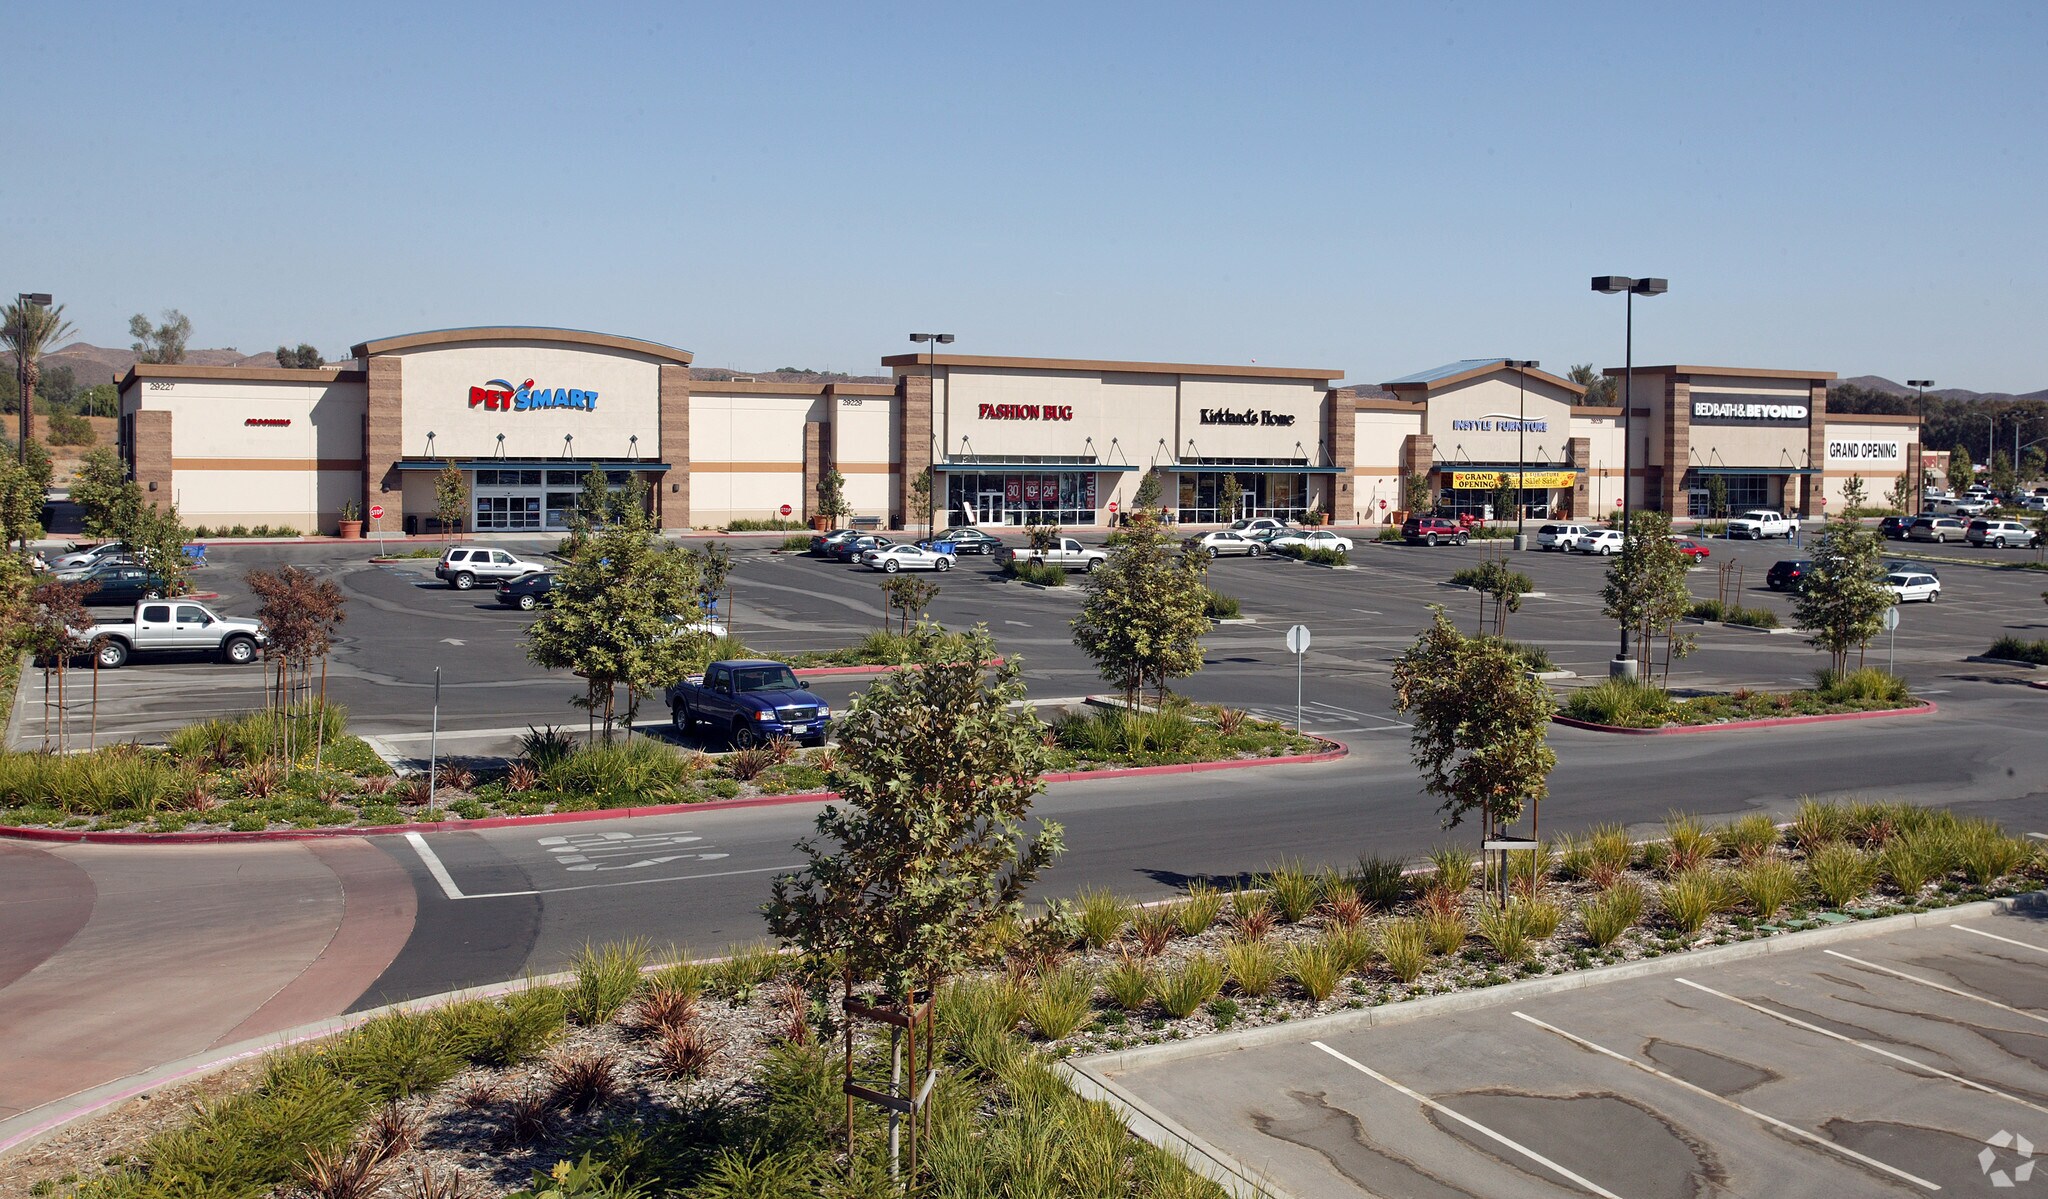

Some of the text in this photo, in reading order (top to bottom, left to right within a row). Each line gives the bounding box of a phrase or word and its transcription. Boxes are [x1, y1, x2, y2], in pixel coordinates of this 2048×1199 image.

[468, 385, 599, 412] PETSMART
[978, 404, 1072, 421] FASHION BUG
[1200, 408, 1295, 427] Kirkland's Home
[1452, 420, 1492, 431] INSTYLE
[1829, 442, 1897, 459] GRAND OPENING
[1007, 484, 1019, 497] 30
